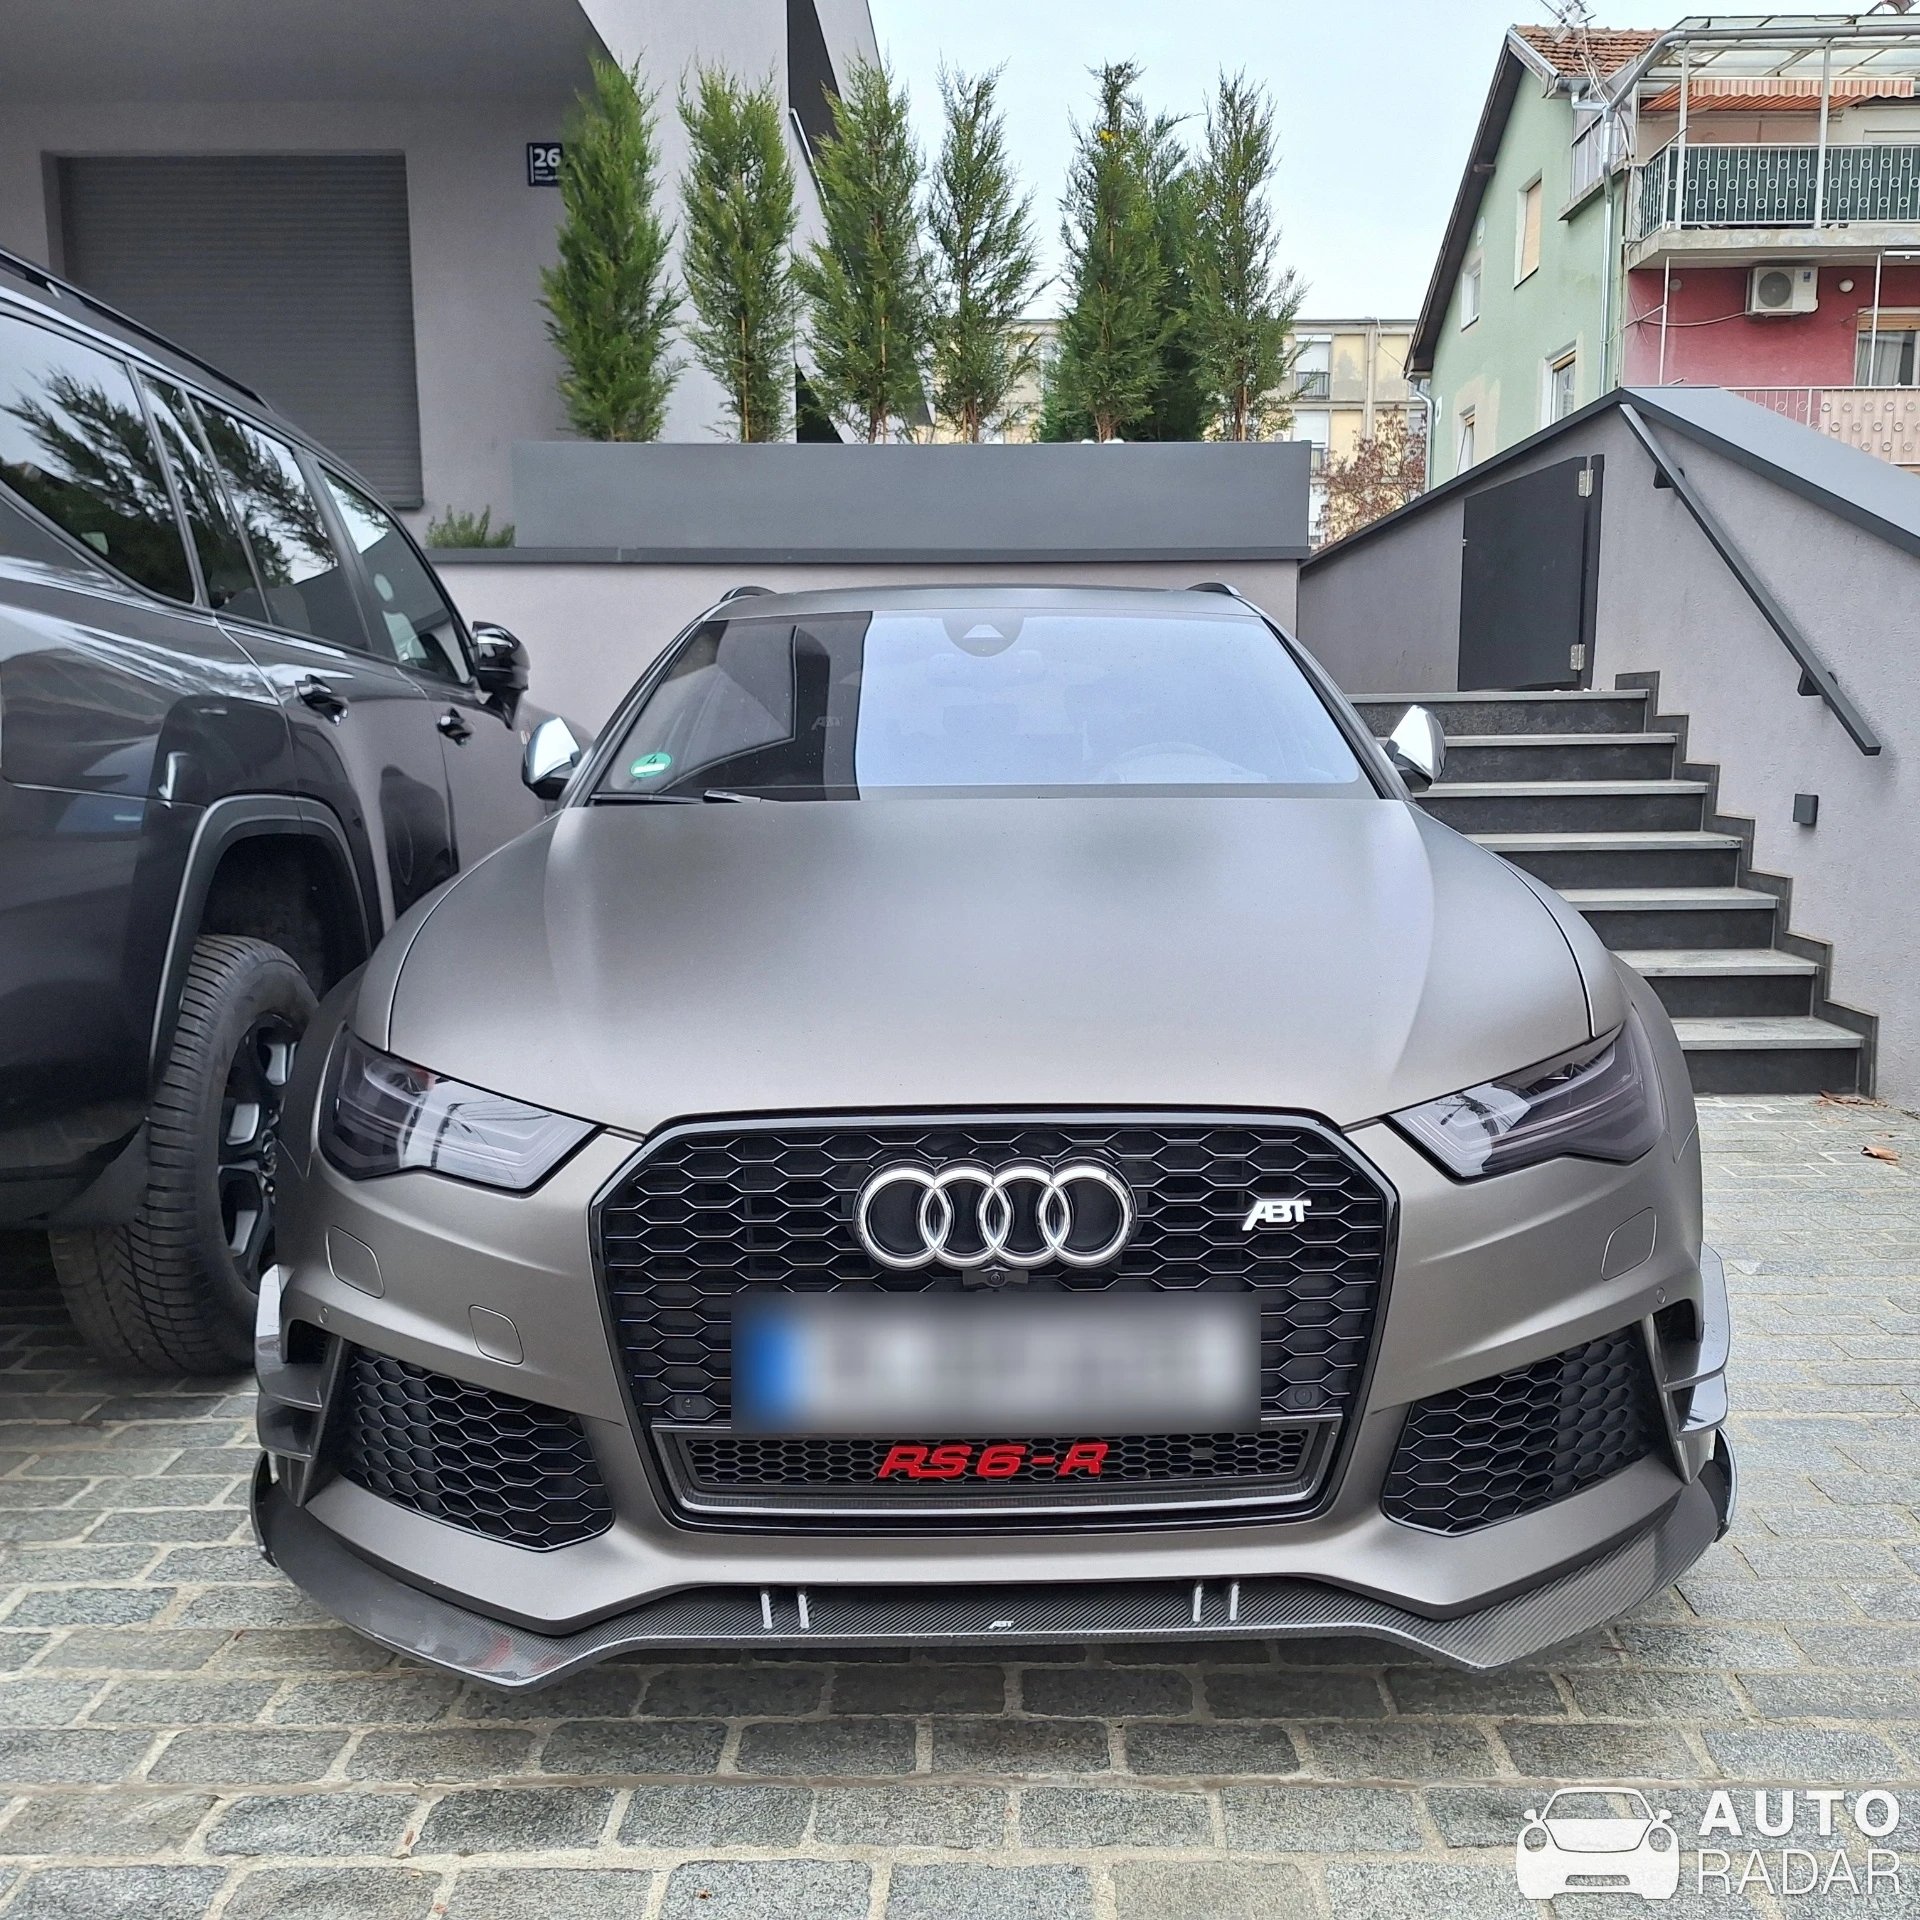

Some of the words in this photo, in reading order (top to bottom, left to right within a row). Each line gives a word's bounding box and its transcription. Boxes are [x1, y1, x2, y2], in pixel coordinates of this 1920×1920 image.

[533, 148, 561, 167] 26
[1241, 1200, 1312, 1231] ABT
[878, 1442, 1109, 1478] RS6-R
